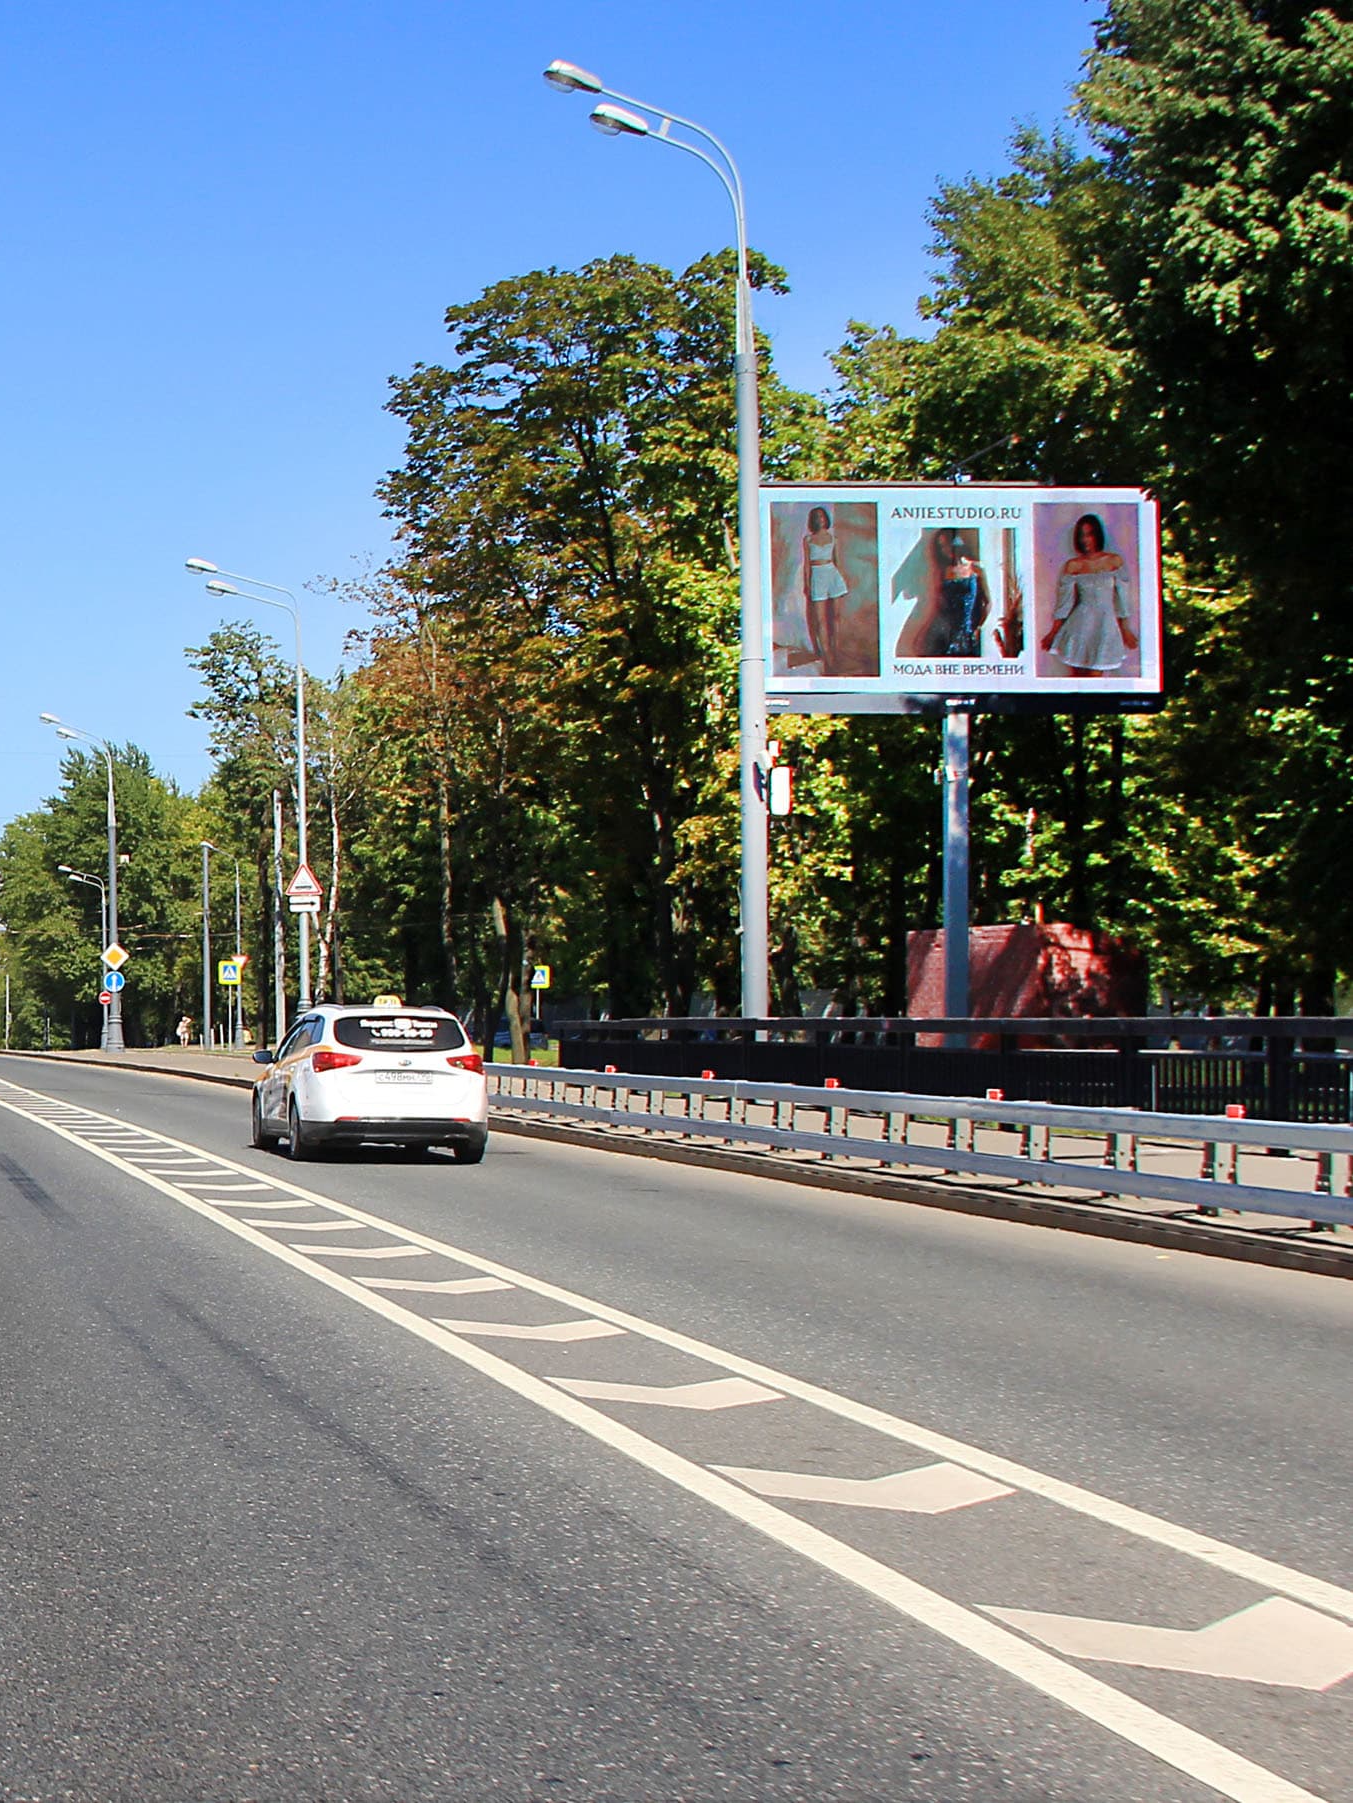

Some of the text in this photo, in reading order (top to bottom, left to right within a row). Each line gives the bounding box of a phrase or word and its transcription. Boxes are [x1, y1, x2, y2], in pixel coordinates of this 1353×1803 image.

[890, 506, 1022, 520] ANJIESTUDIO.RU
[893, 664, 1025, 676] МОДА ВНЕ ВРЕМЕНИ
